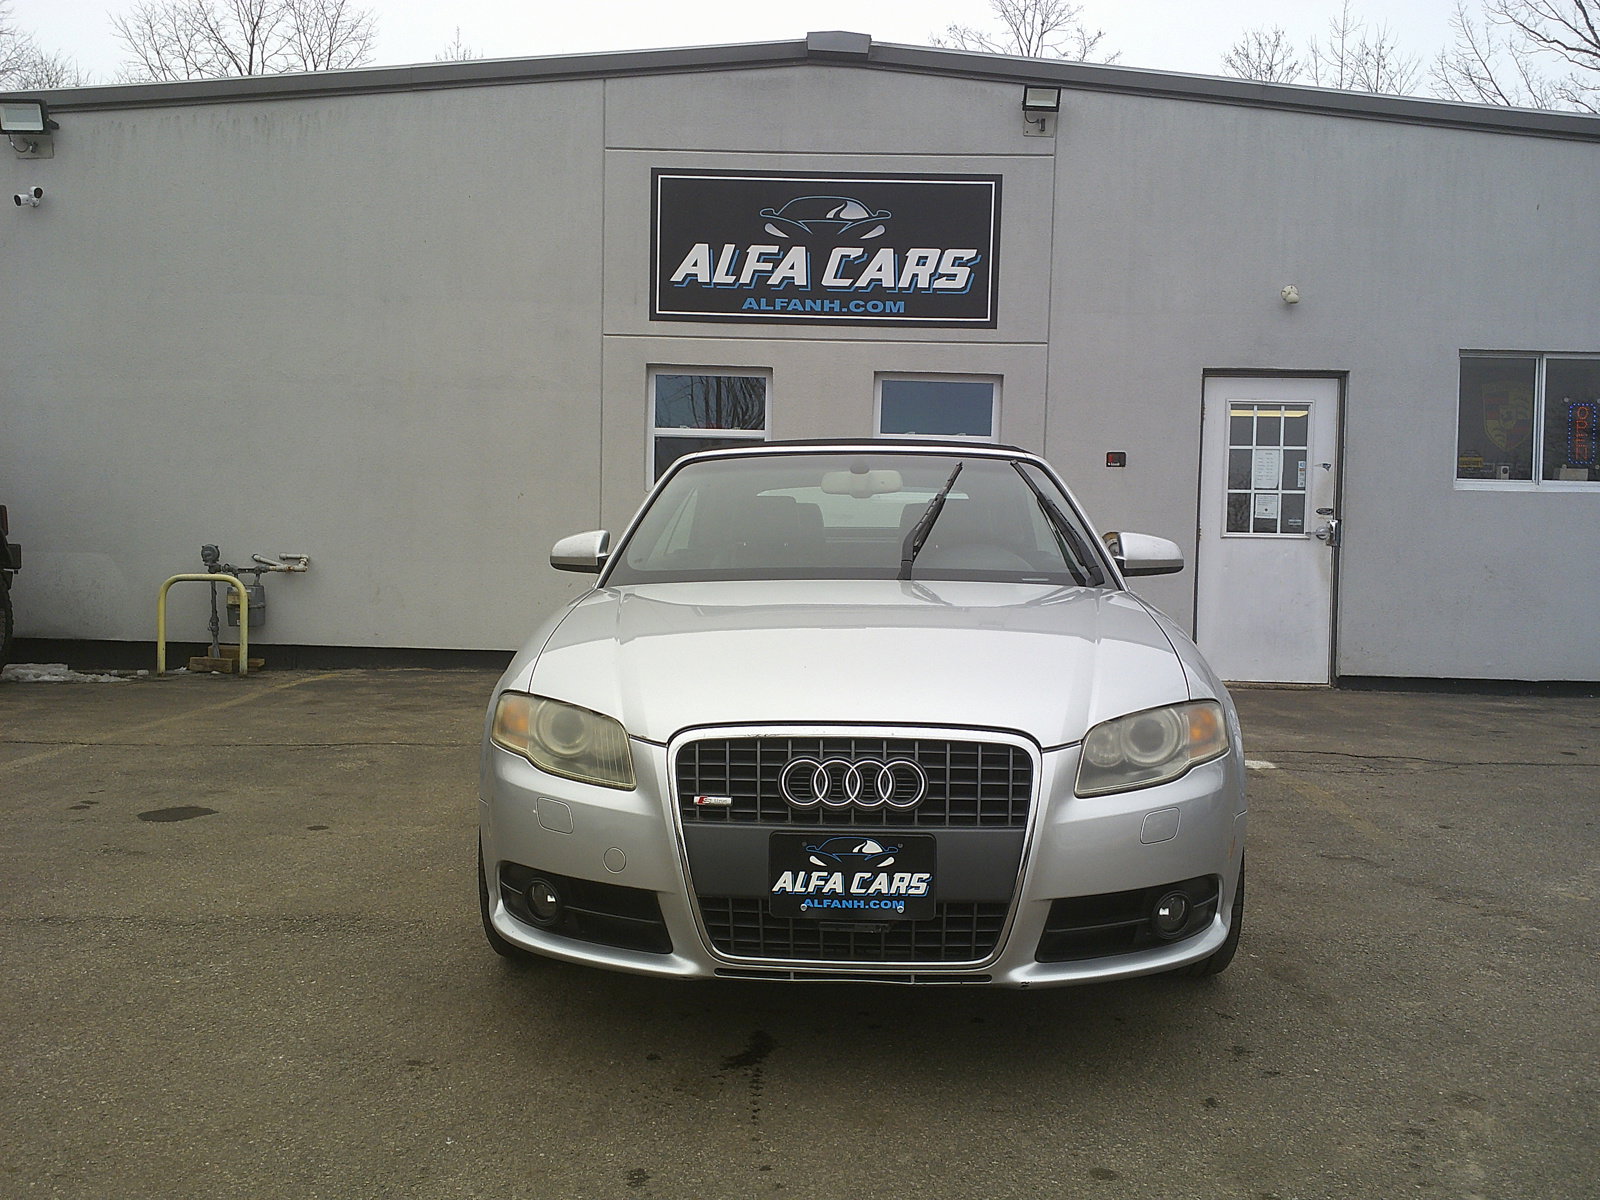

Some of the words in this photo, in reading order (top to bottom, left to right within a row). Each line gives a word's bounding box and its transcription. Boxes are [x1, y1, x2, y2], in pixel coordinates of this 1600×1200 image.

[670, 243, 812, 291] ALFA
[821, 246, 982, 295] CARS
[742, 297, 906, 314] ALFANH.COM
[771, 870, 846, 896] ALFA
[850, 872, 933, 897] CARS
[803, 898, 905, 910] ALFANH.COM
